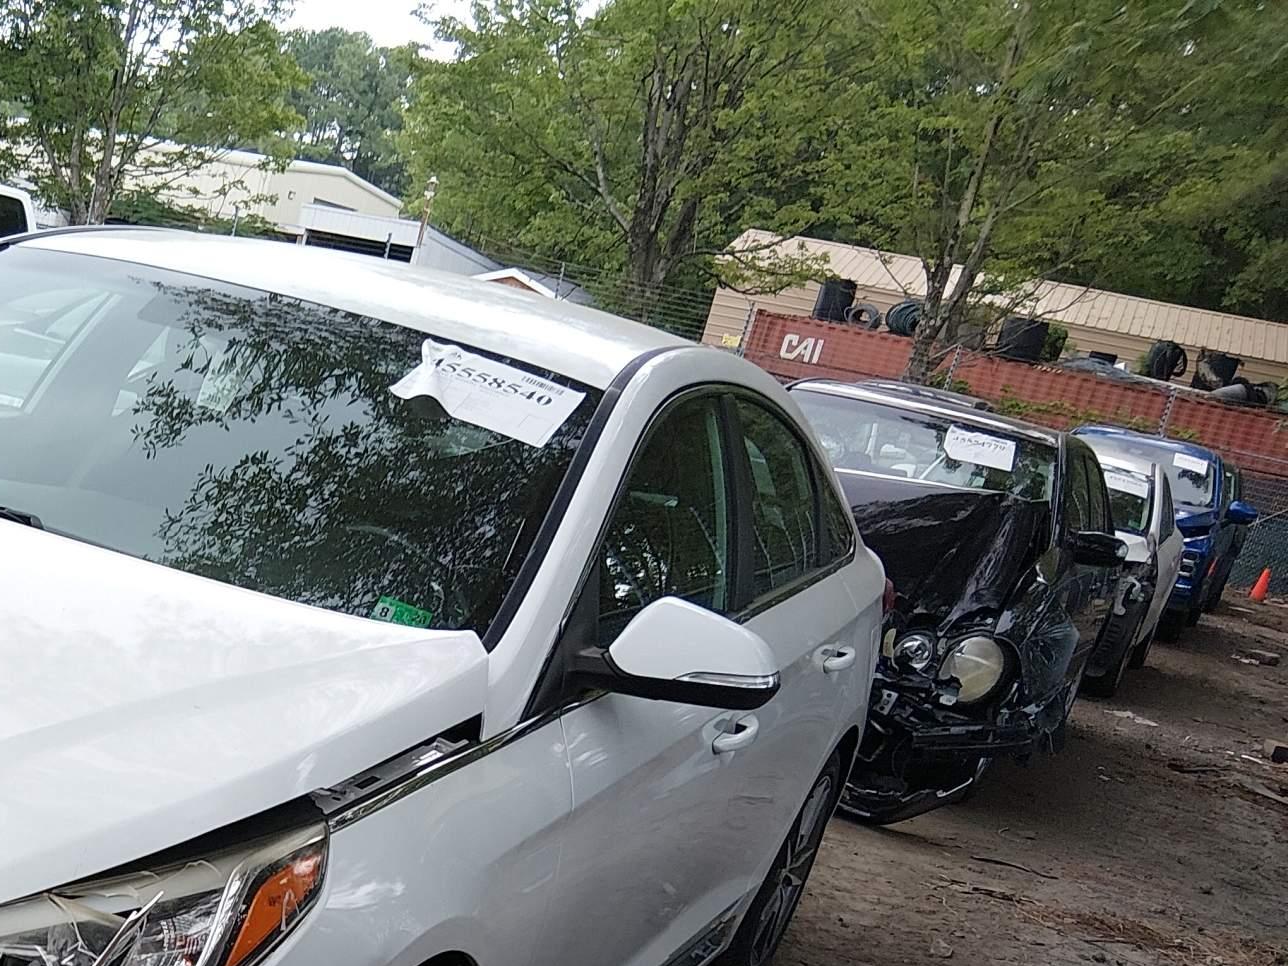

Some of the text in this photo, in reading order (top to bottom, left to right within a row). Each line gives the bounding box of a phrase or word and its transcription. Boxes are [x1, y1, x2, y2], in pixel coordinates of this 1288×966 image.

[779, 333, 824, 364] CAI
[432, 357, 553, 406] 45558540
[379, 607, 390, 618] 8
